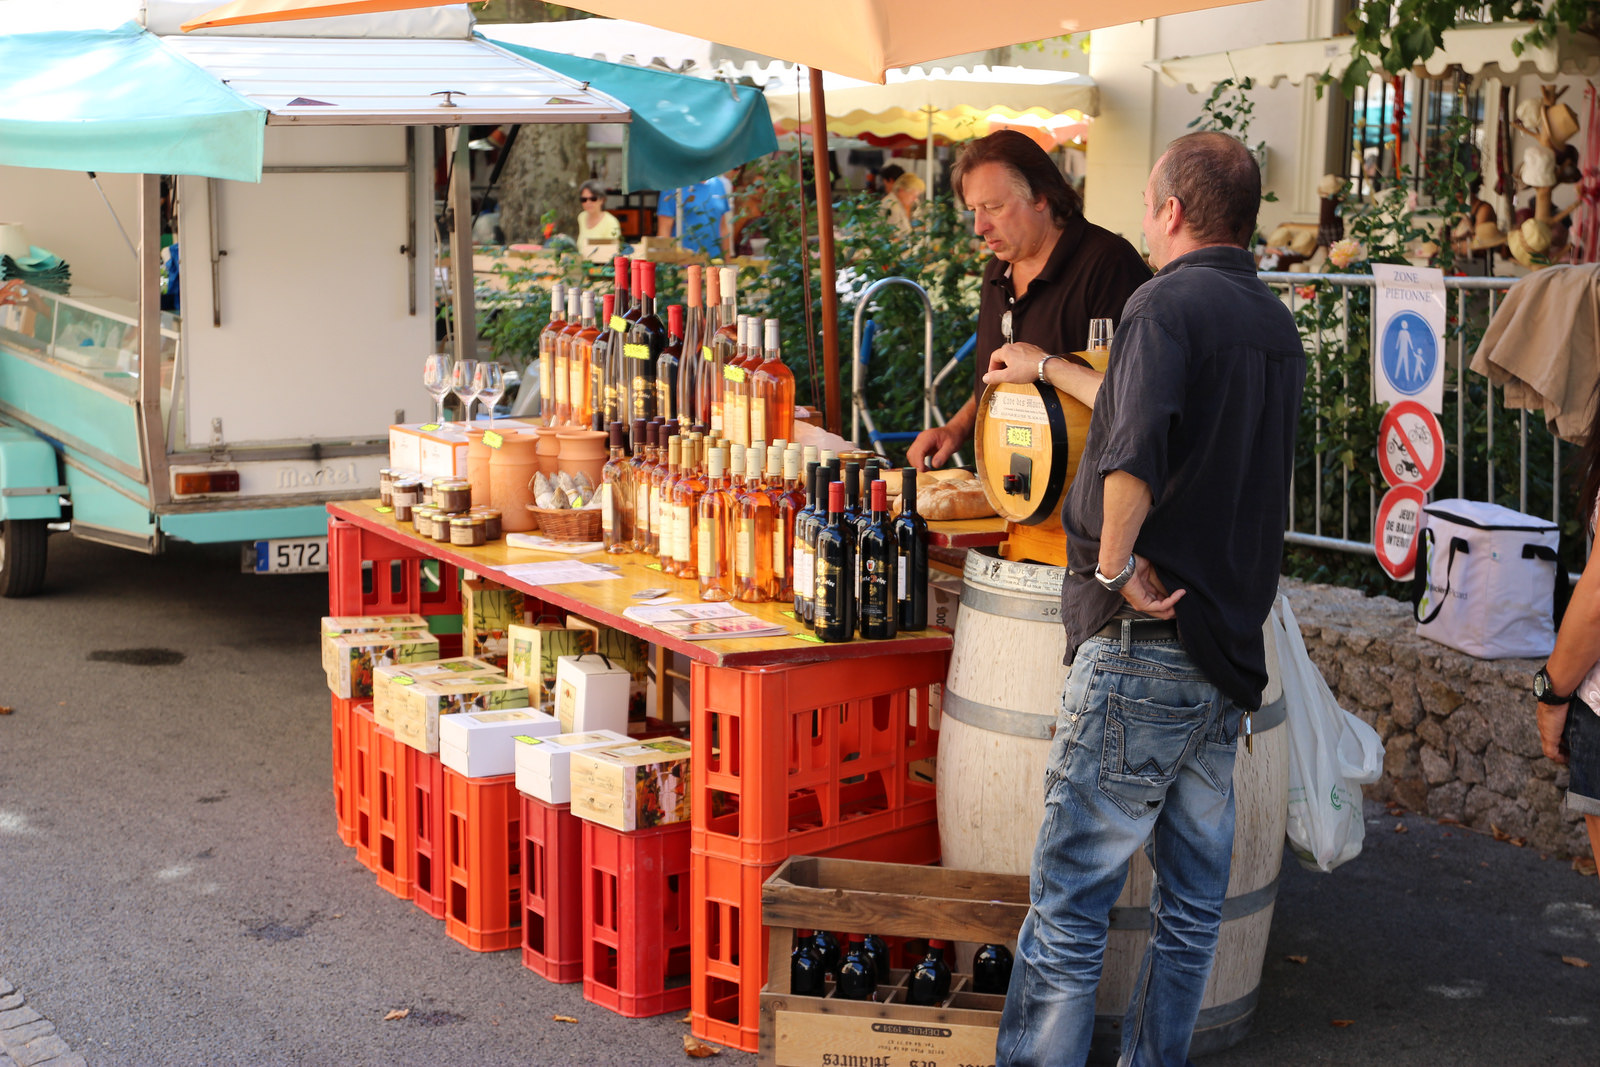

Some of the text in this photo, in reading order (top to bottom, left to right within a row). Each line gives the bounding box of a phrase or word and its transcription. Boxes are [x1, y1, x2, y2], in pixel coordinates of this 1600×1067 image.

[1393, 271, 1420, 283] ZONE
[1385, 287, 1432, 302] PIETONNE
[276, 462, 360, 489] Martel
[1399, 507, 1416, 520] JEUX
[1386, 520, 1394, 531] DE
[277, 543, 321, 568] 572
[883, 1025, 940, 1036] DEPUIS 1934
